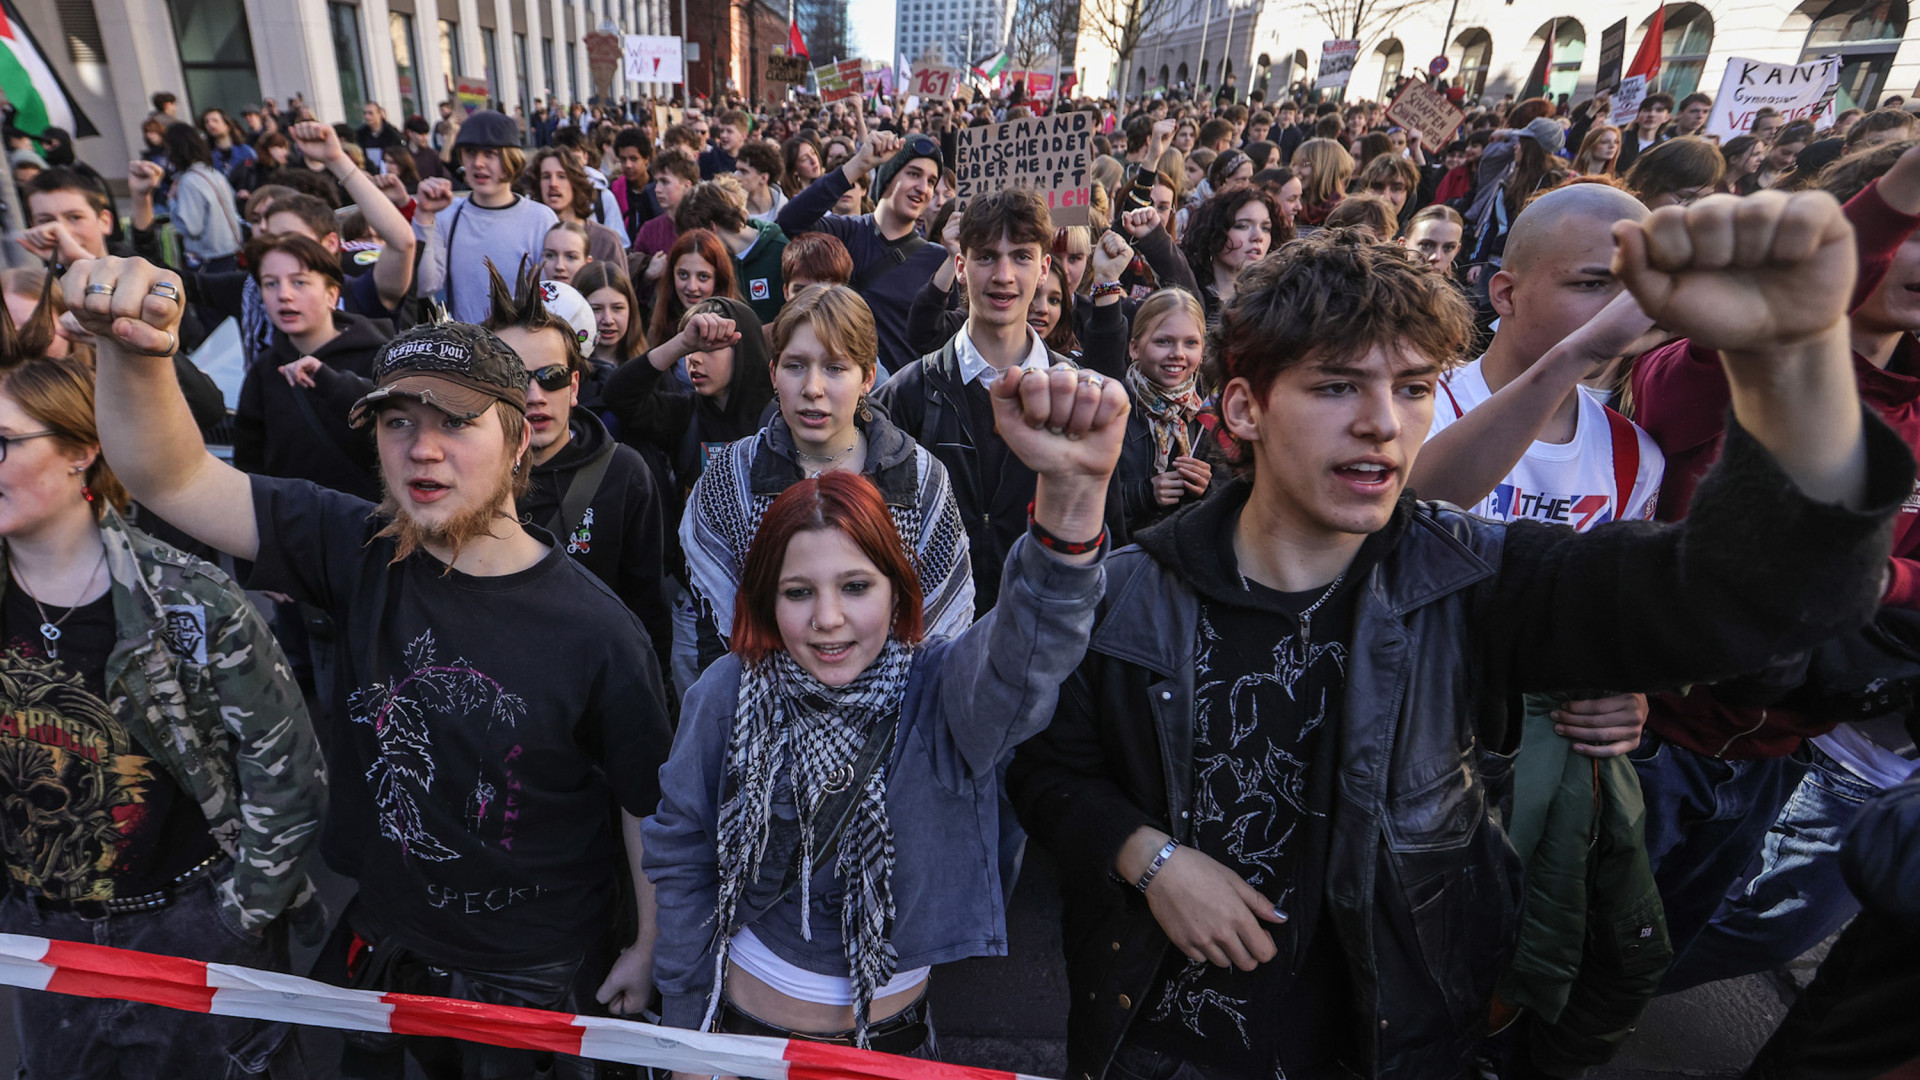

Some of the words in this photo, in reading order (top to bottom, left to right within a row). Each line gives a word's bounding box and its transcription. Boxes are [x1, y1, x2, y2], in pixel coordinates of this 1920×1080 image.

[915, 68, 949, 96] 161
[1739, 61, 1835, 85] KANT
[1413, 84, 1457, 117] FRIEDEN
[958, 114, 1086, 146] NIEMAND
[957, 131, 1090, 163] ENTSCHEIDET
[957, 160, 1008, 181] ÜBER
[1015, 153, 1086, 174] MEINE
[1048, 187, 1089, 209] ICH
[388, 341, 433, 361] despise
[440, 343, 464, 360] you
[1521, 494, 1570, 521] THE
